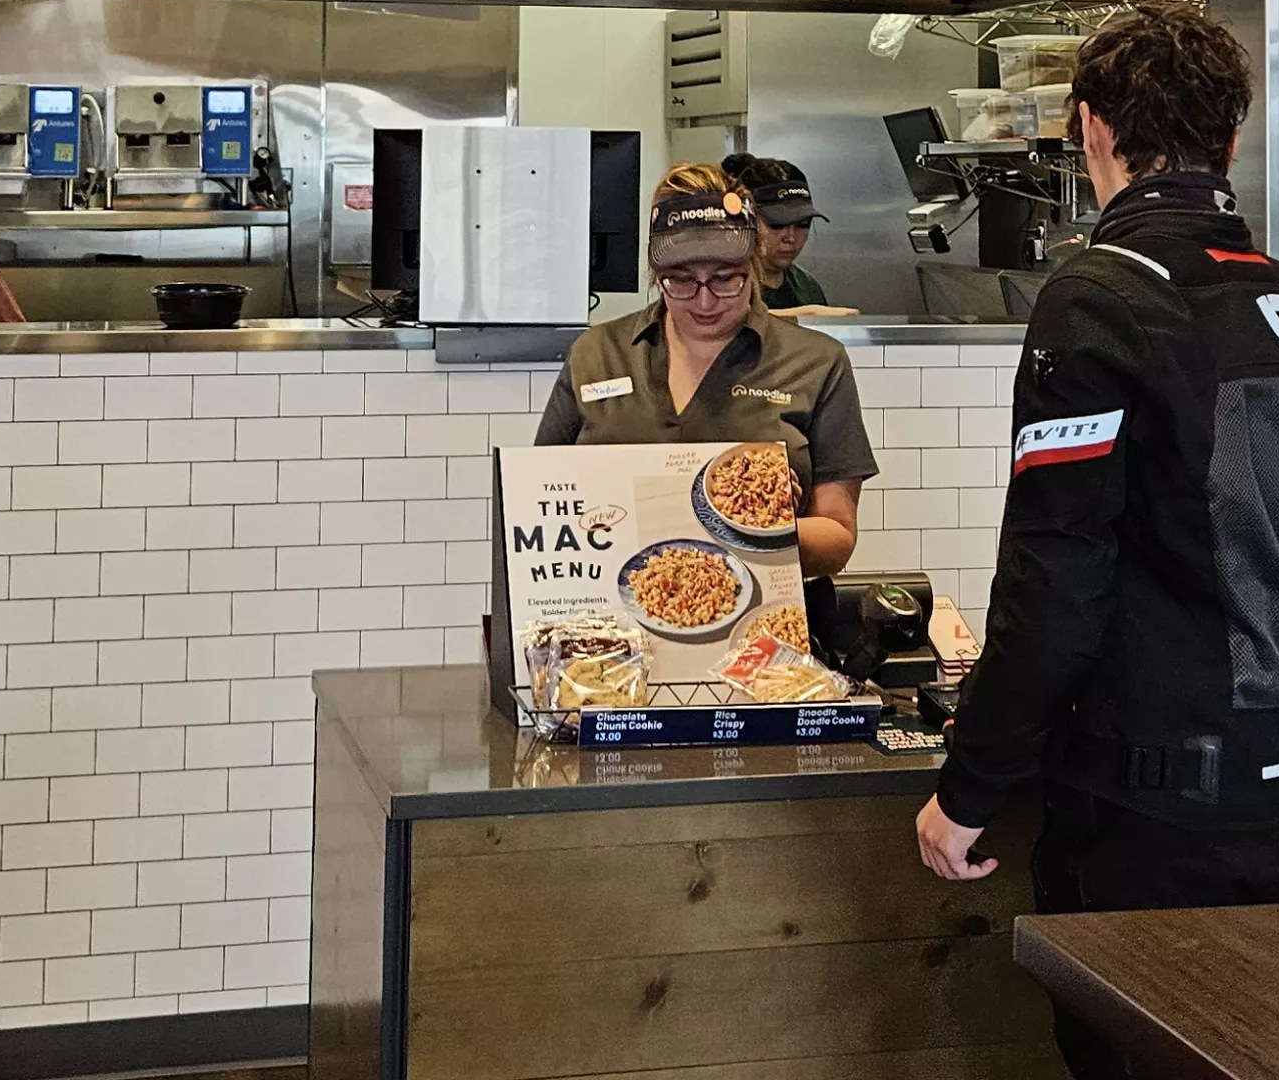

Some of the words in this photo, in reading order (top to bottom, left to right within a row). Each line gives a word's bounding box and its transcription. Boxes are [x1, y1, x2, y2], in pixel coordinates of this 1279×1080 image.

[681, 207, 726, 220] noodles
[538, 500, 584, 516] THE
[589, 510, 617, 524] NEW
[513, 524, 613, 553] MAC
[531, 562, 602, 582] MENU
[597, 712, 646, 721] Chocolate
[715, 711, 736, 719] Rice
[798, 708, 837, 717] Snoodle
[714, 719, 745, 730] Crispy
[797, 717, 831, 725] Doodle
[832, 715, 865, 725] Cookie
[595, 721, 627, 730] Chunk
[629, 721, 663, 730] Cookie
[595, 732, 621, 742] $3.00
[713, 730, 738, 739] $3.00
[796, 727, 821, 737] $3.00
